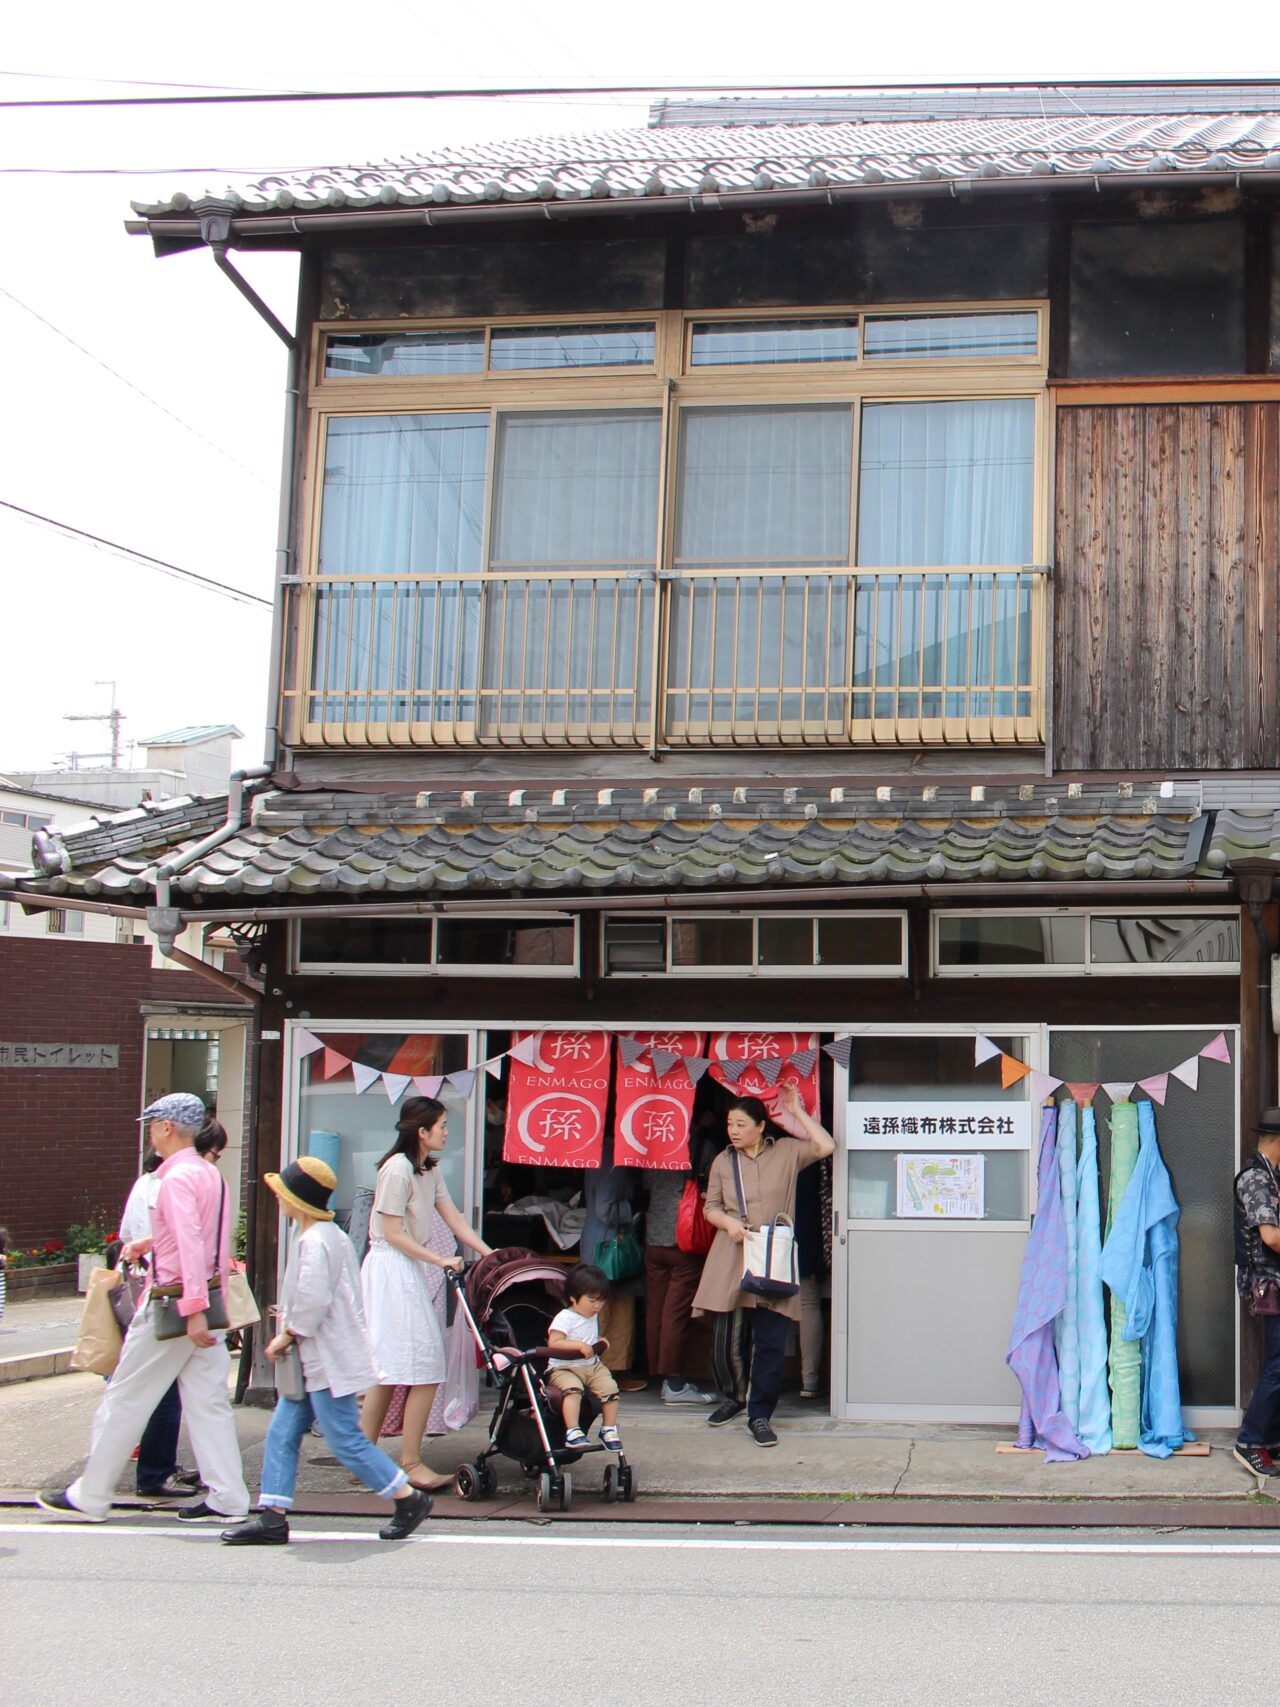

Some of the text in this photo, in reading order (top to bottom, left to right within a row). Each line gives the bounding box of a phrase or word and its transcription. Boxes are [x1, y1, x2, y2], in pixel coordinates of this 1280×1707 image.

[526, 1076, 608, 1089] ENMAGO
[624, 1077, 697, 1090] ENMAGO
[538, 1108, 582, 1140] 孫
[642, 1110, 676, 1143] 孫
[863, 1116, 1015, 1135] 遠孫織布株式会社
